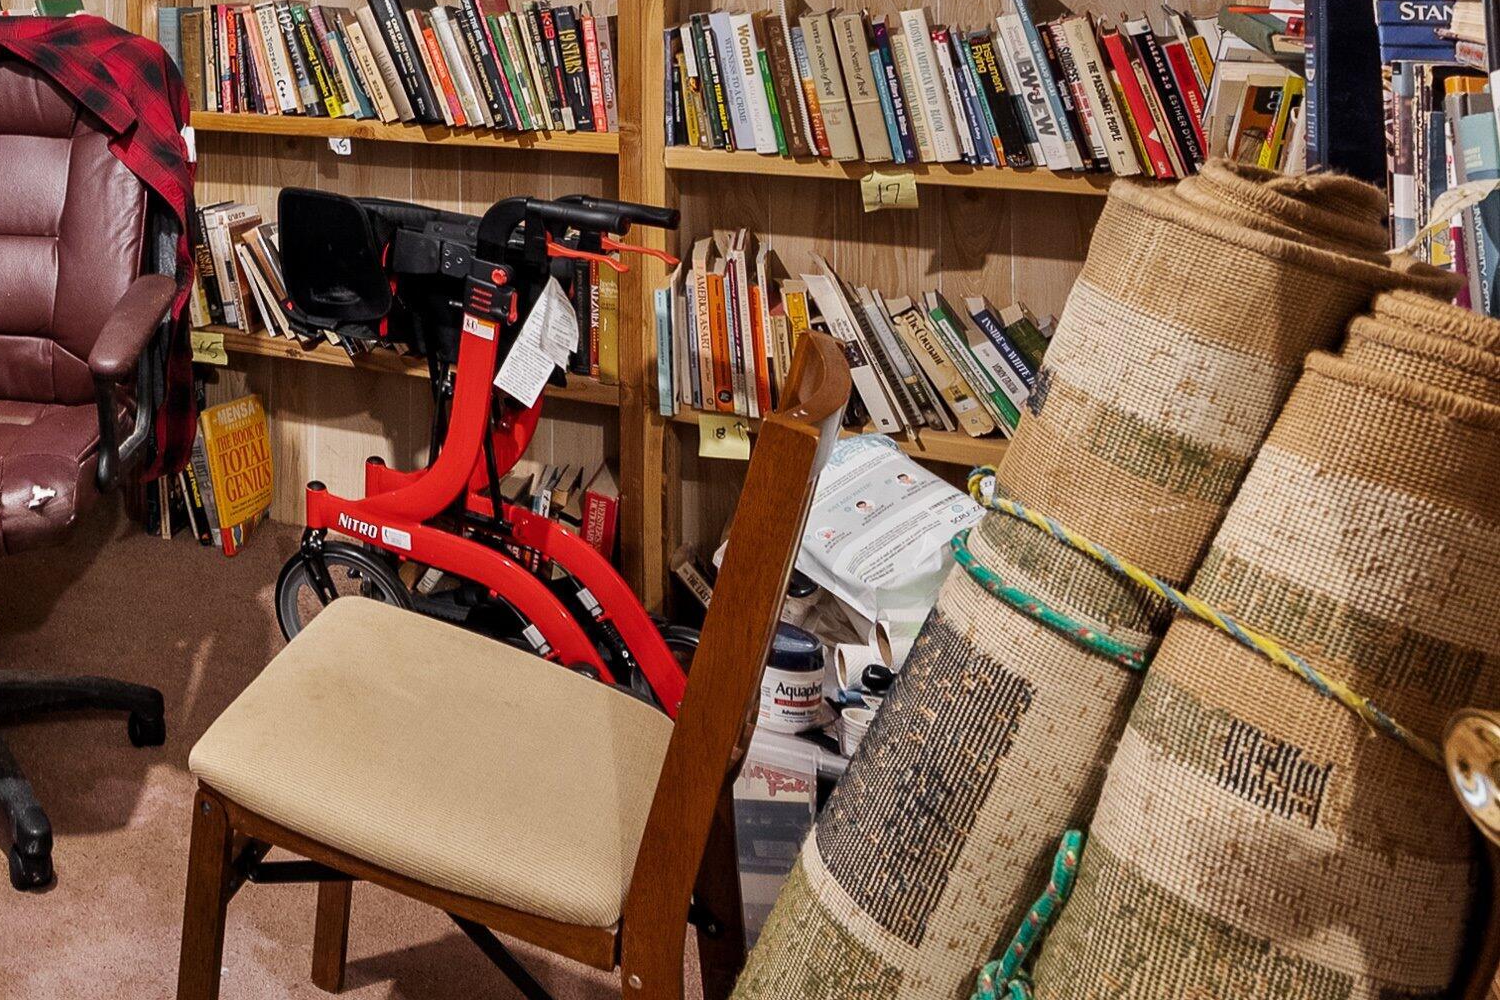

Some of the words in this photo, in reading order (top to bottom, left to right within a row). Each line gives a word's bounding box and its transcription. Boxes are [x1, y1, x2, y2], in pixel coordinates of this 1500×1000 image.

[275, 3, 295, 33] 102
[258, 10, 272, 35] Teach
[265, 36, 282, 77] Yourself
[275, 78, 288, 98] C++
[560, 41, 584, 75] STARS
[736, 24, 757, 75] Woman
[792, 33, 809, 78] Abraham
[970, 44, 987, 74] Flying
[979, 42, 1007, 93] Instrument
[1087, 60, 1098, 74] THE
[724, 37, 737, 74] WITNESS
[735, 95, 747, 123] CRIME
[915, 50, 933, 85] AMERICAN
[925, 86, 938, 105] MIND
[1091, 73, 1112, 116] PASSIONATE
[1145, 35, 1165, 74] RELEASE
[1168, 94, 1186, 127] ESTHER
[1181, 128, 1198, 158] DYSON
[1105, 115, 1122, 142] PEOPLE
[1472, 204, 1486, 275] UNIVERSITY
[695, 274, 708, 316] AMERICA
[699, 318, 709, 330] AS
[700, 332, 710, 350] ART
[904, 312, 921, 330] The
[913, 327, 945, 367] Covenant
[980, 317, 1005, 344] INSIDE
[1005, 349, 1032, 379] WHITE
[217, 400, 255, 424] MENSA
[233, 428, 253, 446] BOOK
[255, 421, 265, 438] OF
[220, 438, 270, 477] TOTAL
[225, 461, 271, 502] GENIUS
[338, 512, 378, 539] NITRO
